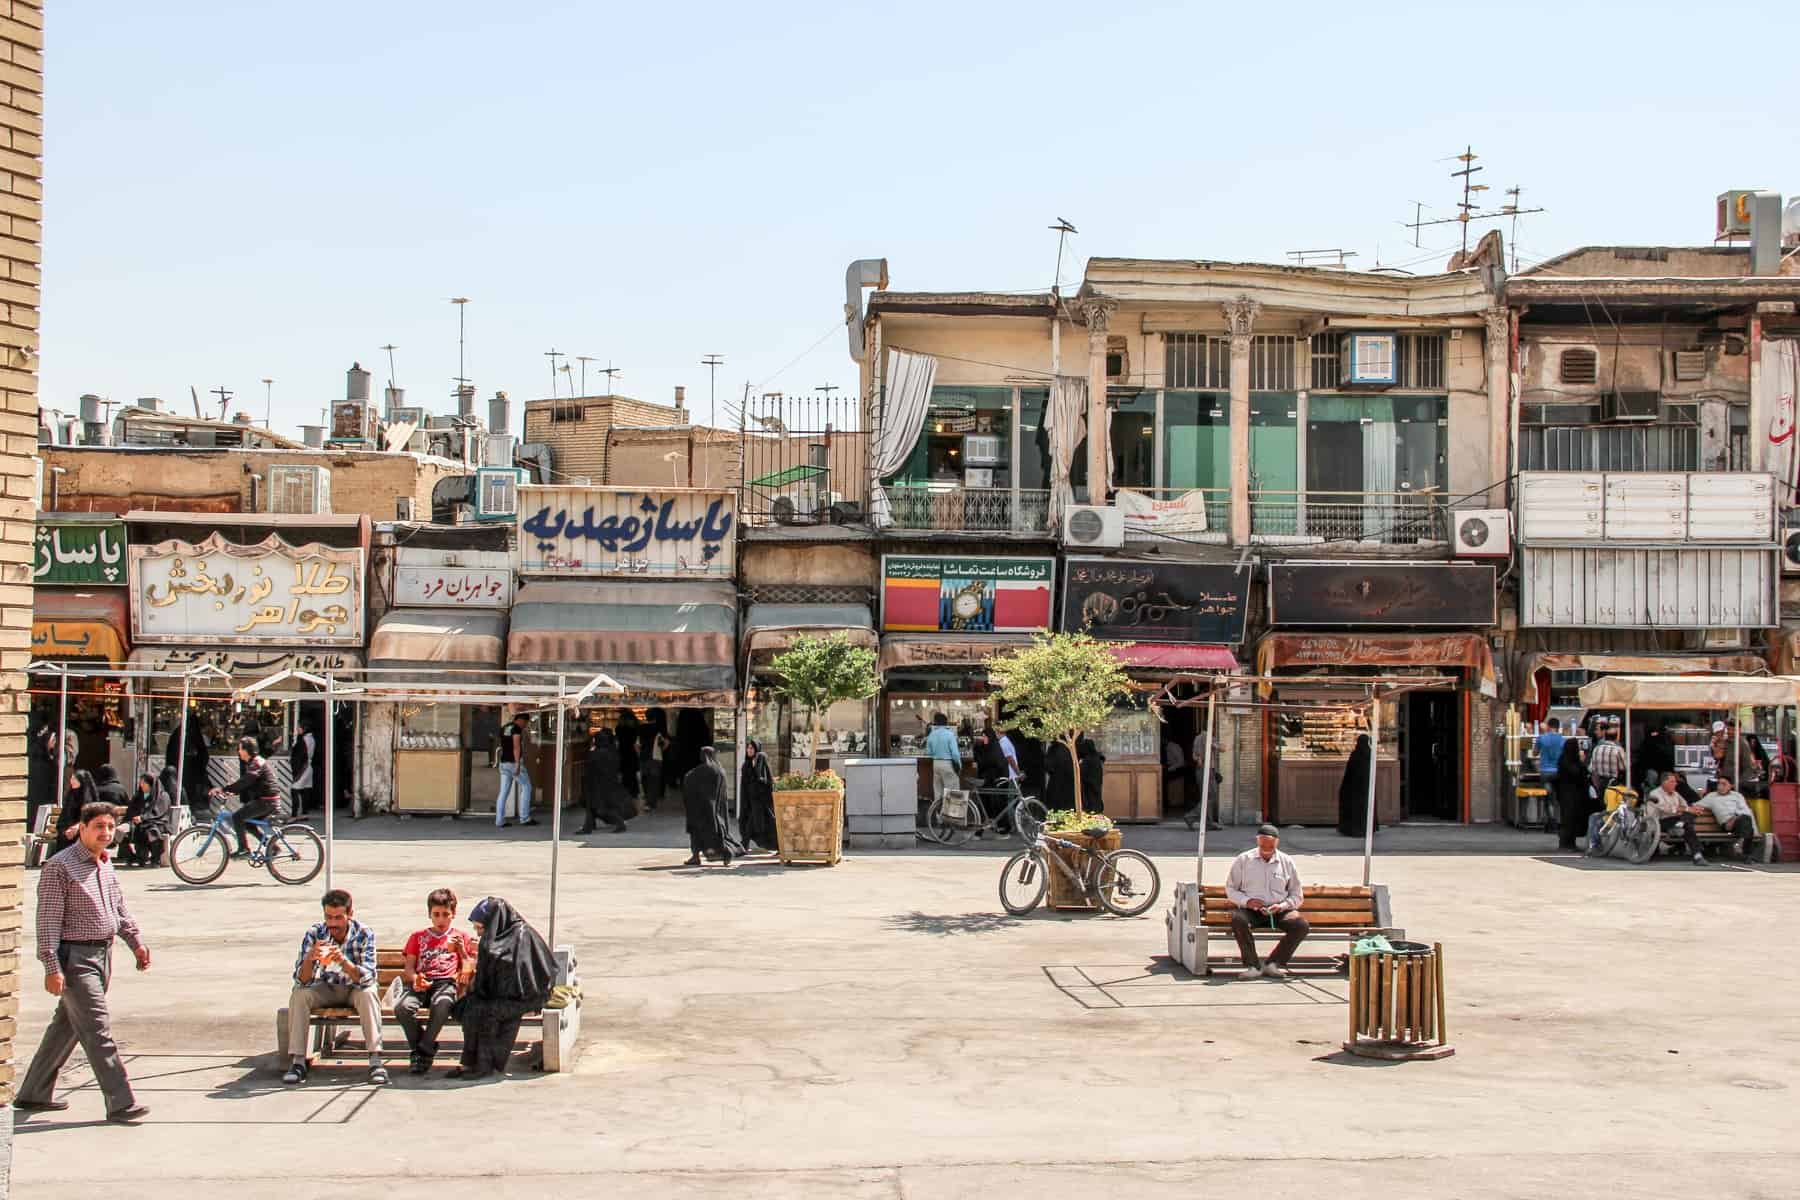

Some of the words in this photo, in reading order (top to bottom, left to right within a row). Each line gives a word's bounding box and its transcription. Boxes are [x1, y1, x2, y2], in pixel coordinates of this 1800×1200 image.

[522, 505, 641, 553] مهدیه
[621, 497, 732, 560] پاساژ
[34, 526, 121, 582] پاساژ
[289, 562, 349, 595] طلا
[943, 563, 979, 576] تماشا
[979, 564, 1007, 576] ساعت
[1006, 564, 1046, 579] فروشگاه
[423, 578, 445, 600] فرد
[446, 575, 502, 602] جواهریان
[1199, 591, 1237, 602] طلا
[234, 598, 349, 635] جواهر
[1198, 605, 1237, 616] جواهر
